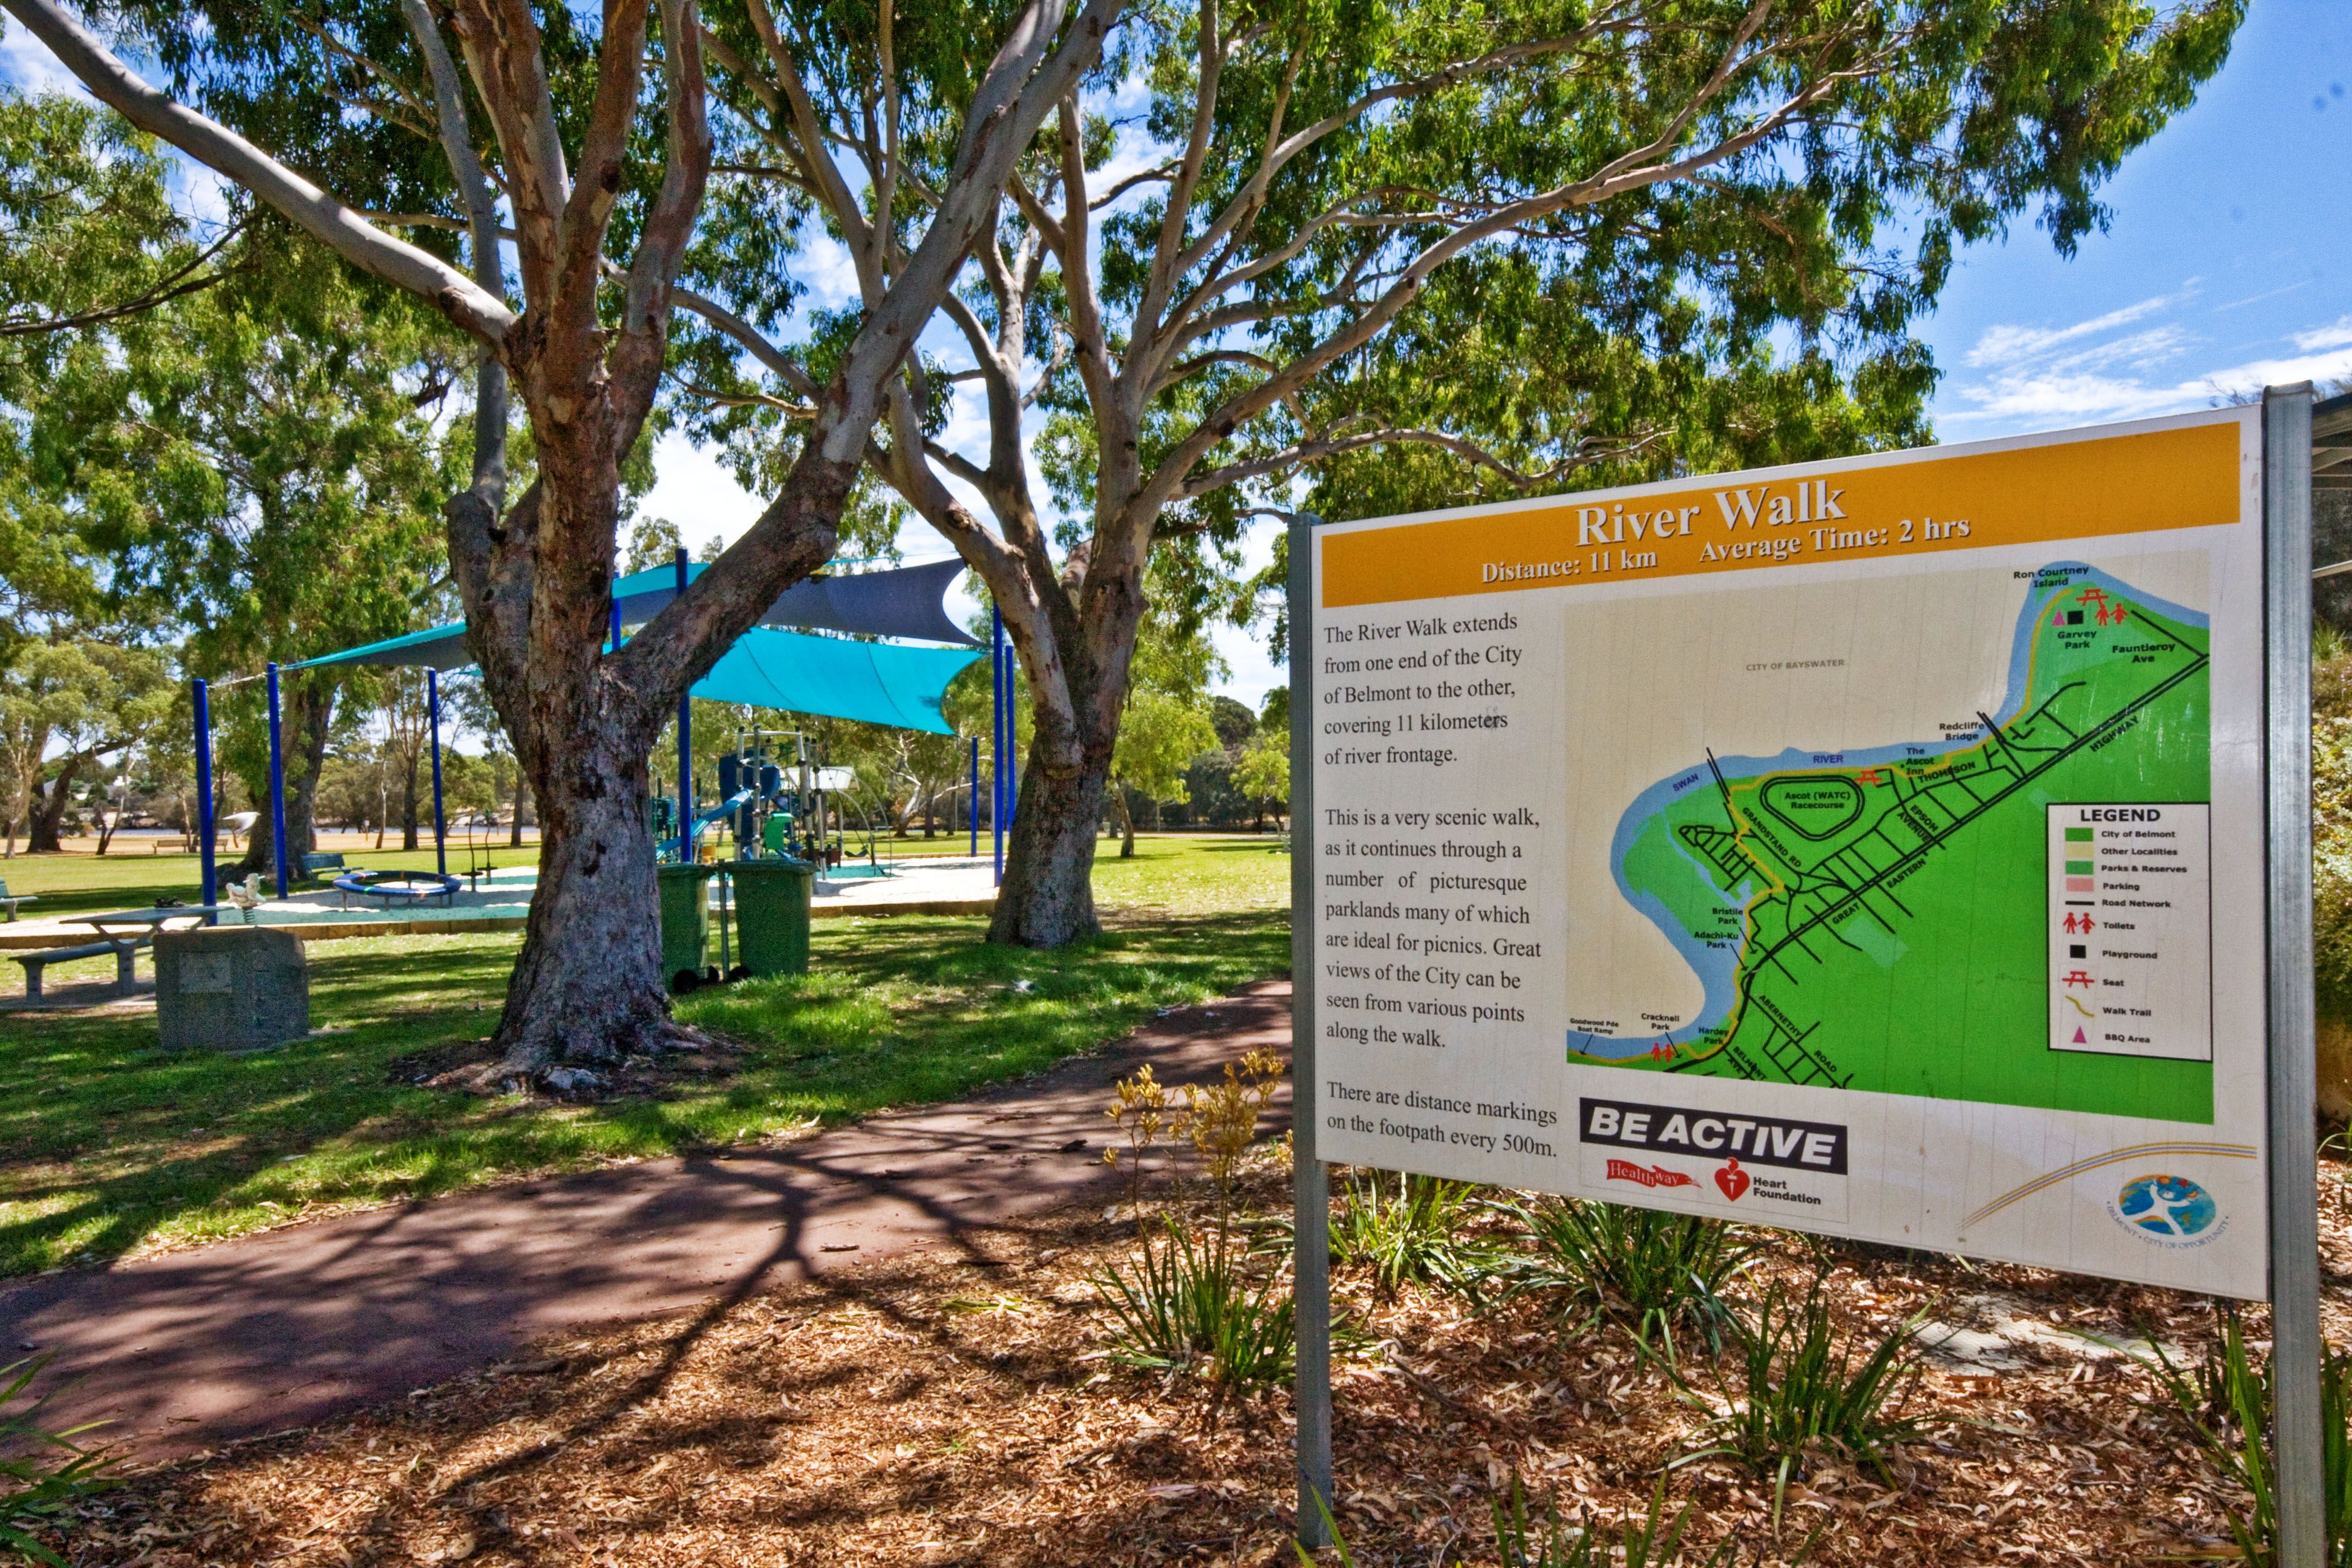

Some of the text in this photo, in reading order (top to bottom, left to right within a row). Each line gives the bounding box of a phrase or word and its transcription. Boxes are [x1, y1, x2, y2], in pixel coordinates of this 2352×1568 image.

[1575, 480, 1847, 548] River Walk
[1481, 517, 1971, 583] Distance: 11 km Average Time: 2 hrs
[2033, 578, 2068, 587] Island
[2038, 566, 2089, 577] Courtney
[1324, 613, 1517, 643] The River Walk extends
[2058, 630, 2097, 639] Garvey
[1325, 646, 1522, 673] from one end of the City
[2112, 642, 2175, 653] Fauntleroy
[1786, 659, 1844, 669] BAYSWATER
[1324, 679, 1515, 704] of Belmont to the other,
[1325, 713, 1508, 736] covering 11 kilometers
[1939, 722, 1985, 730] Redcliffe
[1945, 732, 1979, 740] Bridge
[2089, 717, 2140, 753] HIGHWAY
[1325, 746, 1457, 766] of river frontage.
[1673, 755, 1843, 791] SWAN RIVER
[1814, 792, 1851, 800] (WATC)
[1325, 808, 1540, 829] This is a very scenic walk,
[1897, 812, 1931, 842] AVENUE
[2081, 809, 2161, 822] LEGEND
[1742, 808, 1801, 867] GRANDSTAND RD
[1325, 840, 1521, 862] as it continues through a
[1325, 871, 1527, 895] number of picturesque
[1887, 858, 1926, 888] EASTERN
[1325, 901, 1530, 924] parklands many of which
[1832, 903, 1861, 924] GREAT
[1326, 932, 1541, 957] are ideal for picnics. Great
[2103, 950, 2158, 959] Playground
[1326, 961, 1520, 989] views of the City can be
[1327, 994, 1524, 1022] seen from various points
[1641, 1013, 1679, 1022] Cracknell
[1327, 1022, 1445, 1047] along the walk.
[1759, 995, 1837, 1072] ABERNETHY ROAD
[1327, 1082, 1557, 1127] There are distance markings
[1327, 1114, 1557, 1157] on the footpath every 500m.
[1589, 1106, 1836, 1165] BE ACTIVE
[1610, 1162, 1679, 1186] Healthway
[1754, 1177, 1787, 1190] Heart
[1754, 1187, 1821, 1205] Foundation
[2178, 1220, 2230, 1249] OPPORTUNITY
